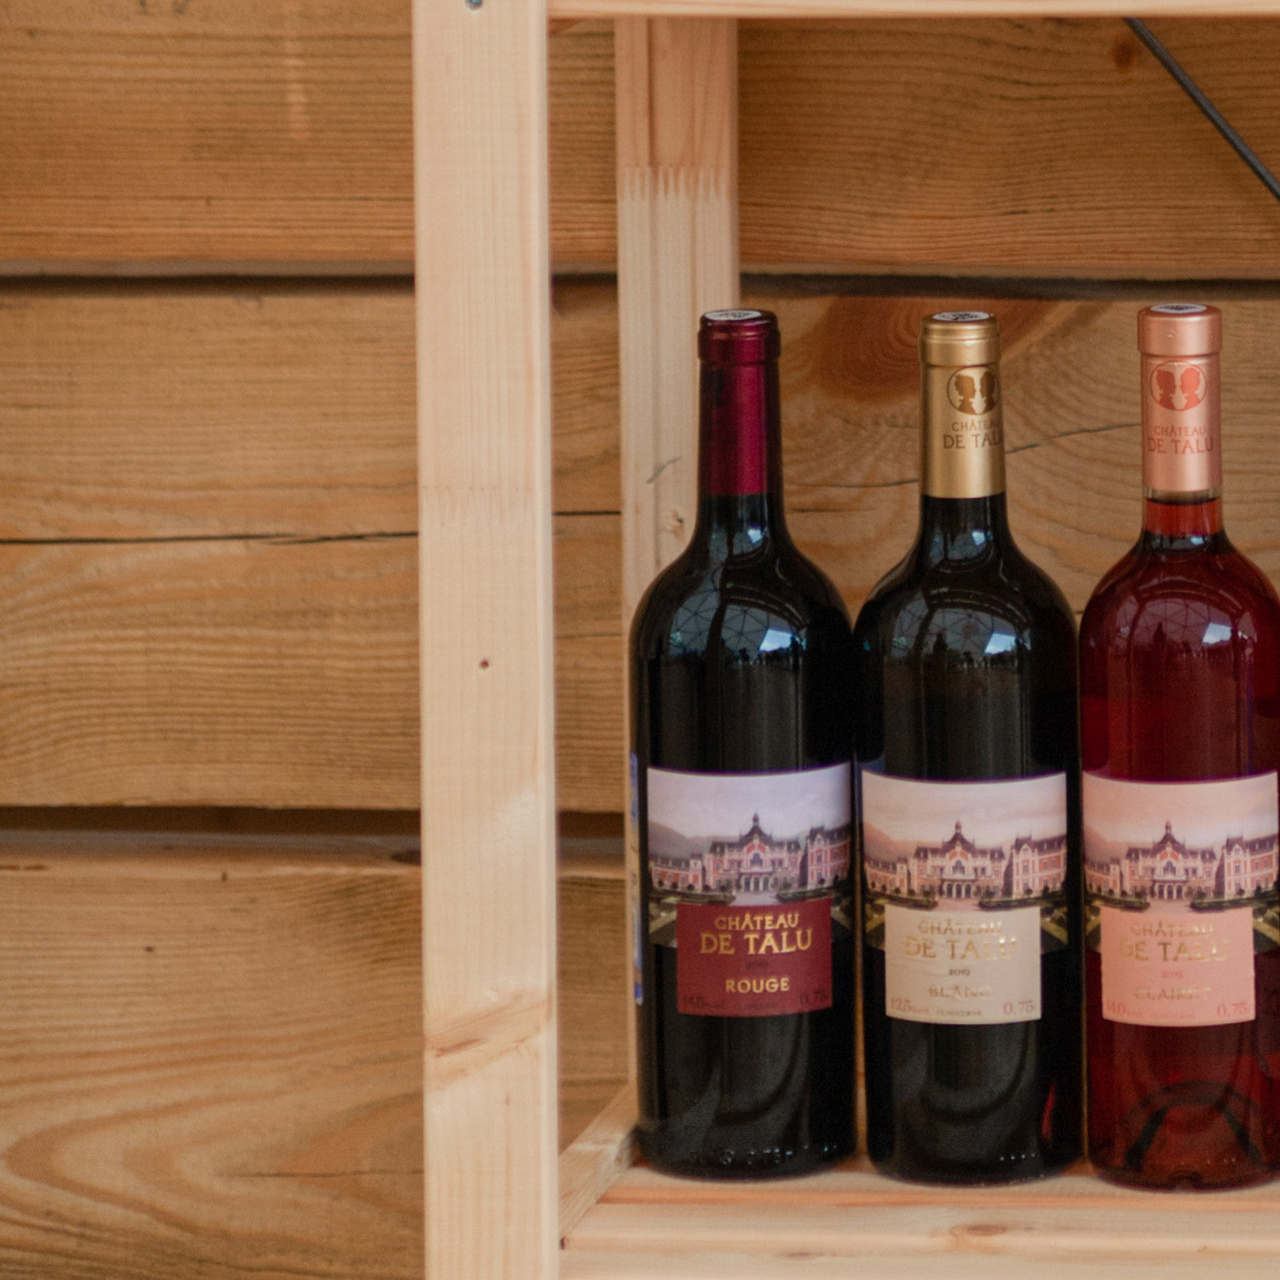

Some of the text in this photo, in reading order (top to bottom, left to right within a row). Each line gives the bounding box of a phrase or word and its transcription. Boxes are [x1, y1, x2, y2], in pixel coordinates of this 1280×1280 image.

[943, 431, 1001, 449] DE TAL
[1148, 437, 1214, 454] DE TALU
[715, 912, 800, 931] CHÂTEAU
[700, 927, 813, 955] DE TALU
[905, 936, 1017, 960] DE TALU
[1119, 939, 1229, 962] DE TALU
[725, 977, 790, 994] ROUGE
